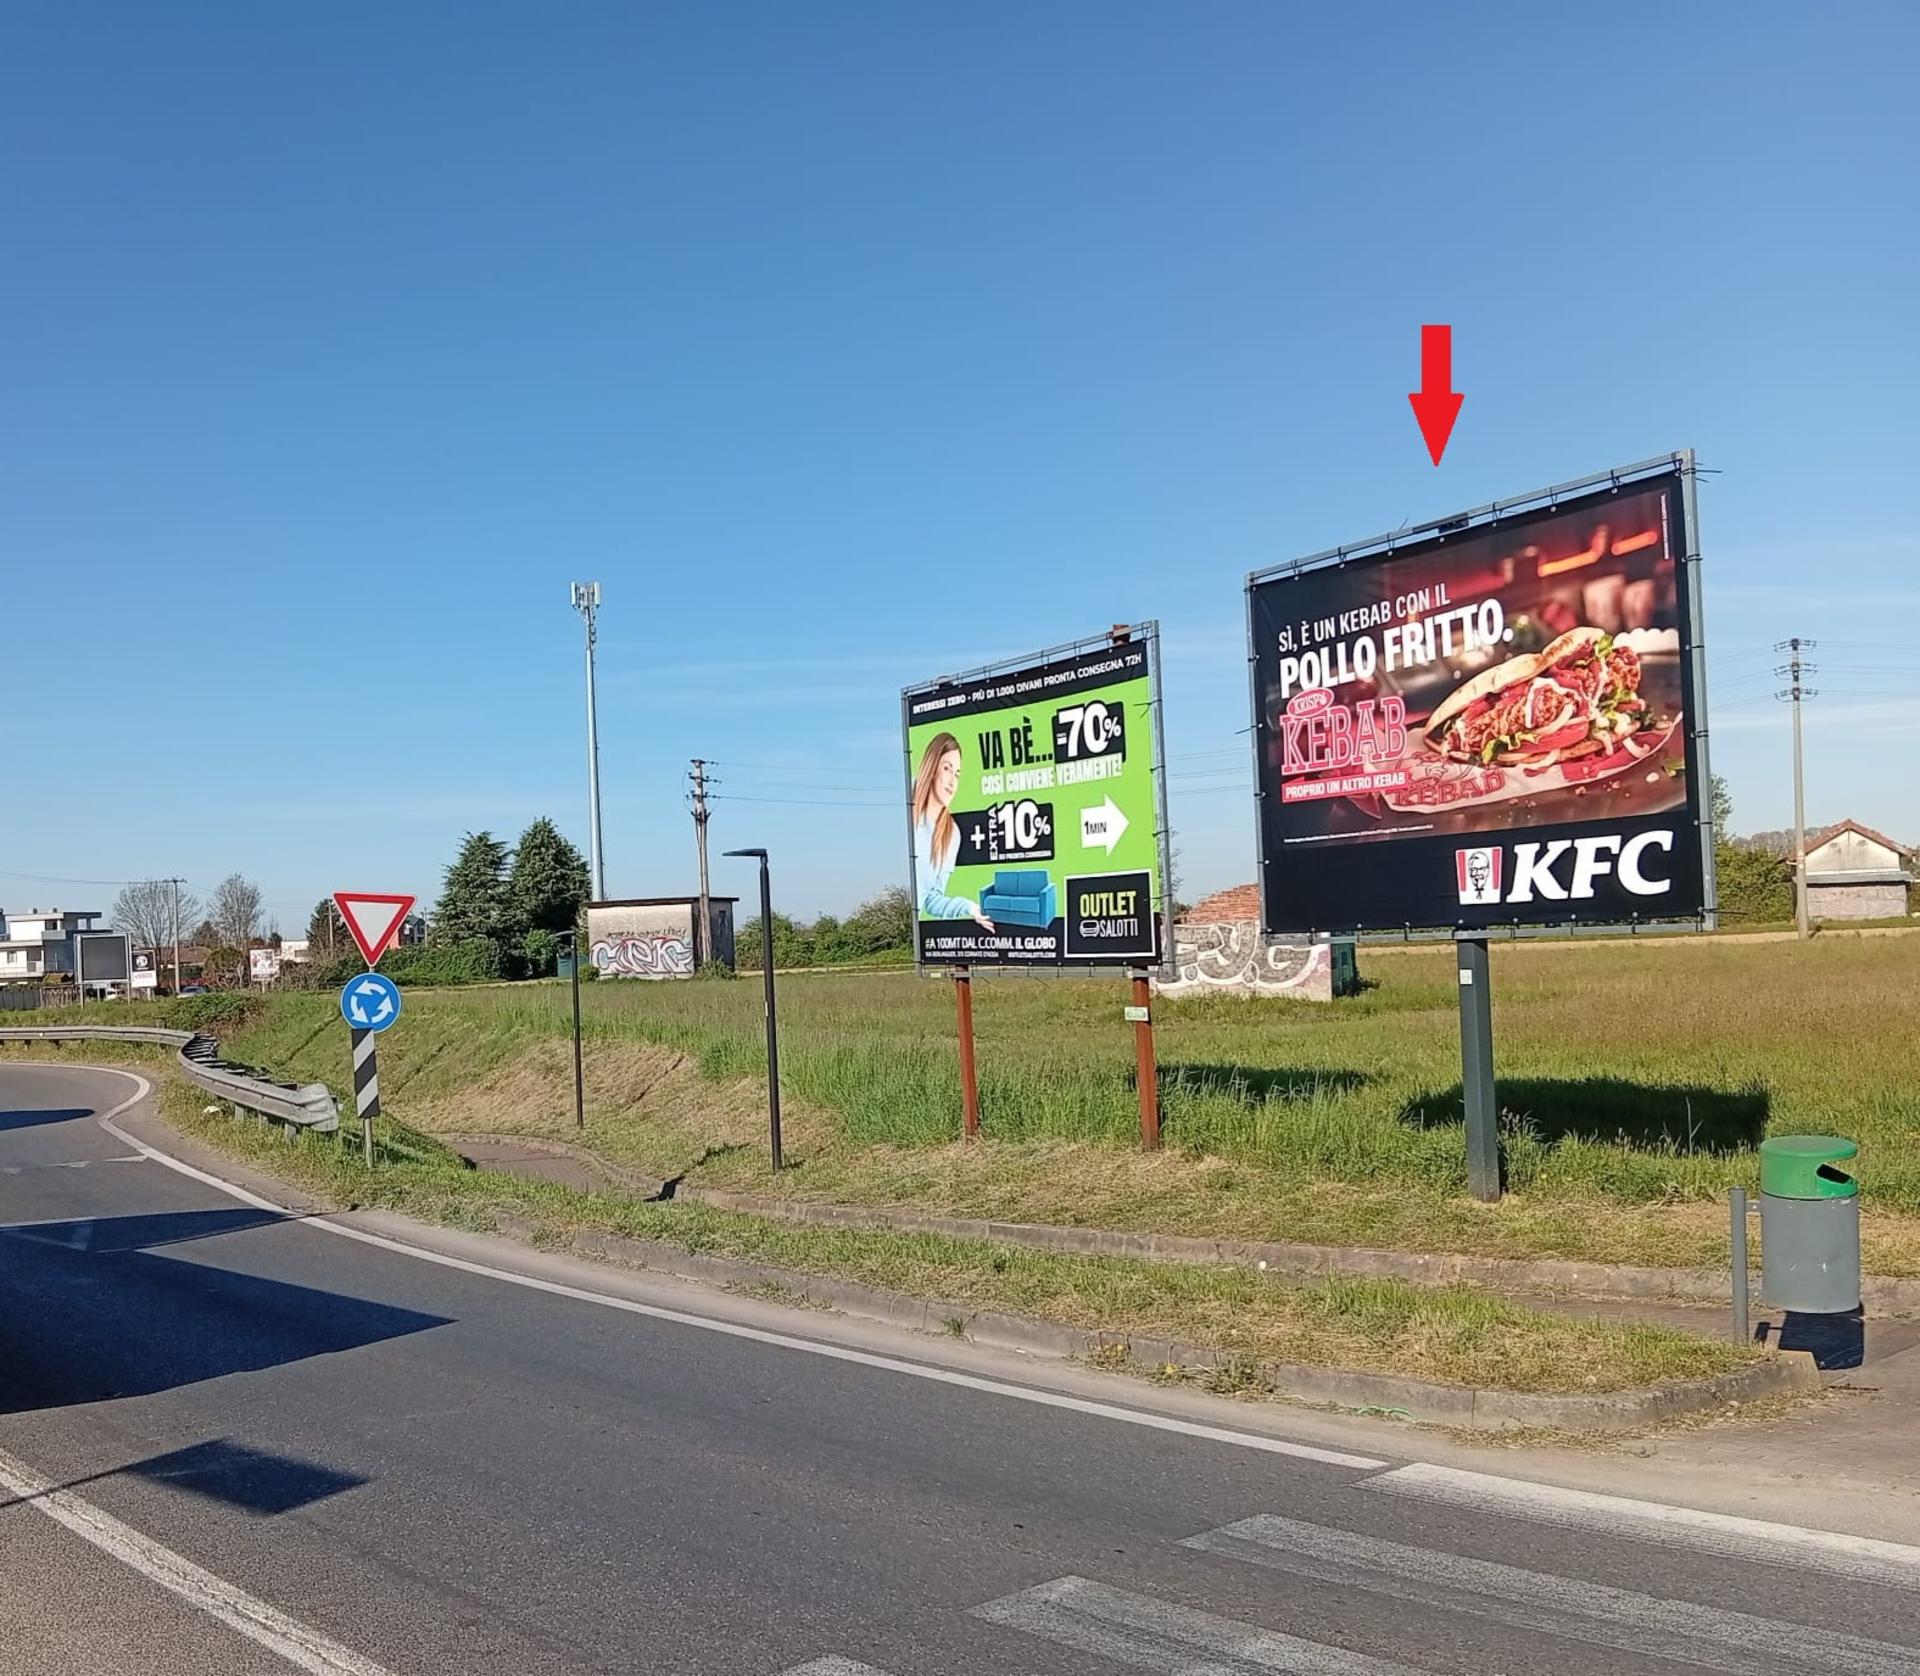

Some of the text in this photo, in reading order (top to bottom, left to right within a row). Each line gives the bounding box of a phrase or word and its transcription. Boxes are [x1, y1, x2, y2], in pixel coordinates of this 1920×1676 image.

[1279, 583, 1451, 653] SÌ, È UN KEBAB CON IL
[1280, 598, 1514, 699] POLLO FRITTO.
[947, 694, 966, 707] ZERO
[972, 689, 984, 702] PIÙ
[986, 690, 995, 699] DI
[1017, 679, 1042, 693] DIVANI
[1044, 670, 1076, 686] PRONTA
[1077, 659, 1124, 677] CONSEGNA
[1125, 653, 1142, 667] 72H
[978, 716, 1053, 770] VA BÈ...
[1280, 696, 1408, 775] KEBAB
[1006, 766, 1055, 792] CONVIENE
[1286, 783, 1325, 799] PROPRIO
[1326, 780, 1340, 793] UN
[1341, 776, 1371, 792] ALTRO
[1373, 773, 1405, 787] KEBAB
[988, 806, 998, 860] EXTRA
[1506, 830, 1673, 903] KFC
[1080, 891, 1136, 917] OUTLET
[1100, 918, 1138, 937] SALOTTI
[962, 937, 977, 949] DAL
[1015, 937, 1023, 949] IL
[1024, 937, 1056, 949] GLOBO
